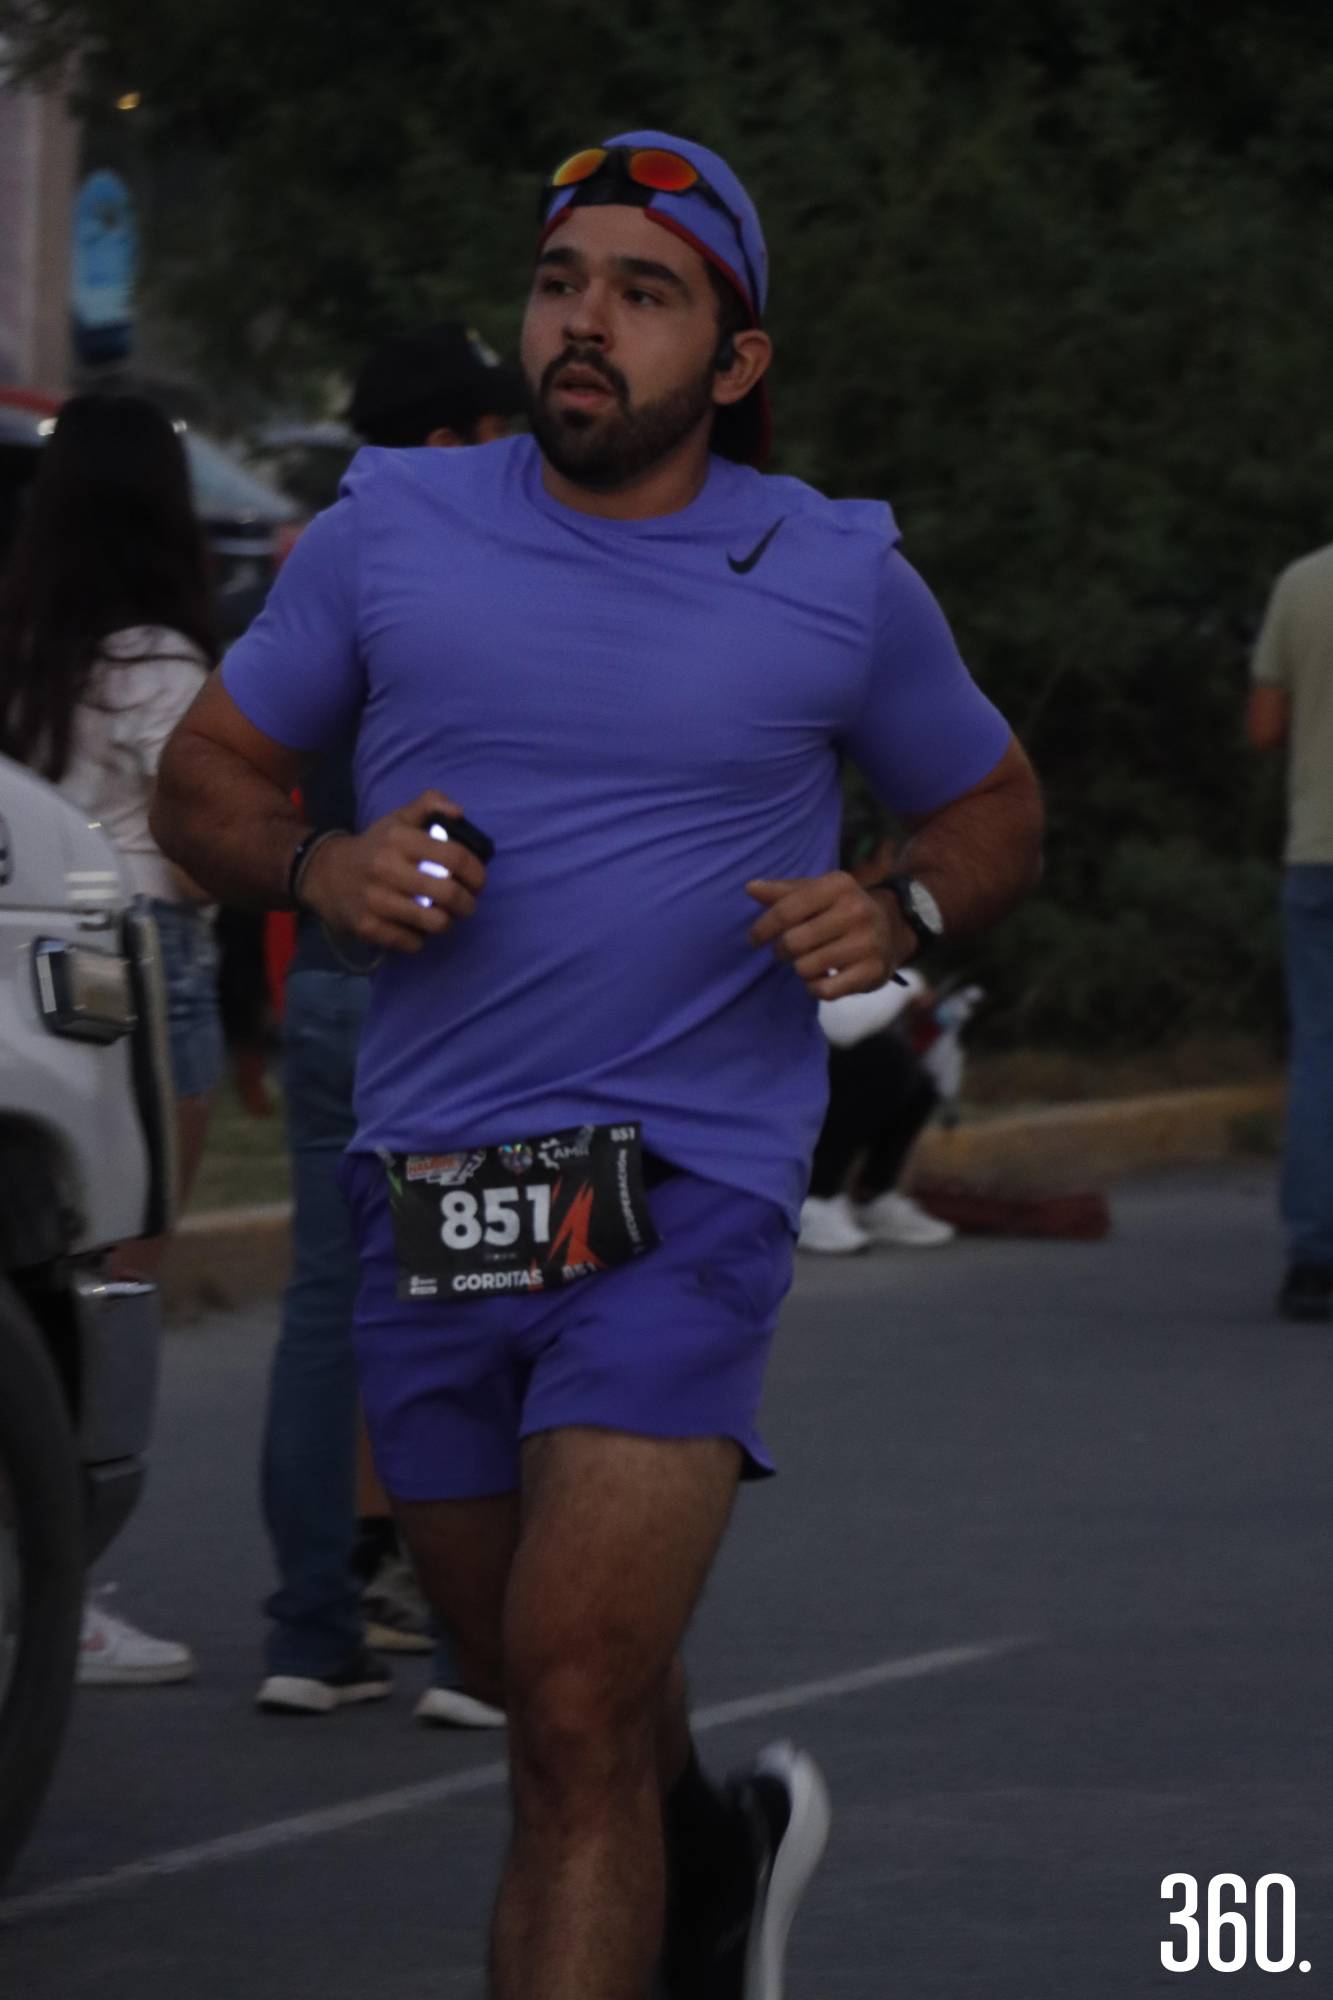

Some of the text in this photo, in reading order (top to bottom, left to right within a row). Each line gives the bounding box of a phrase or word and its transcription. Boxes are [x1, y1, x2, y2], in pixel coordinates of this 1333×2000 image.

[610, 1126, 636, 1142] 851
[441, 1183, 551, 1250] 851
[452, 1269, 544, 1291] GORDITAS
